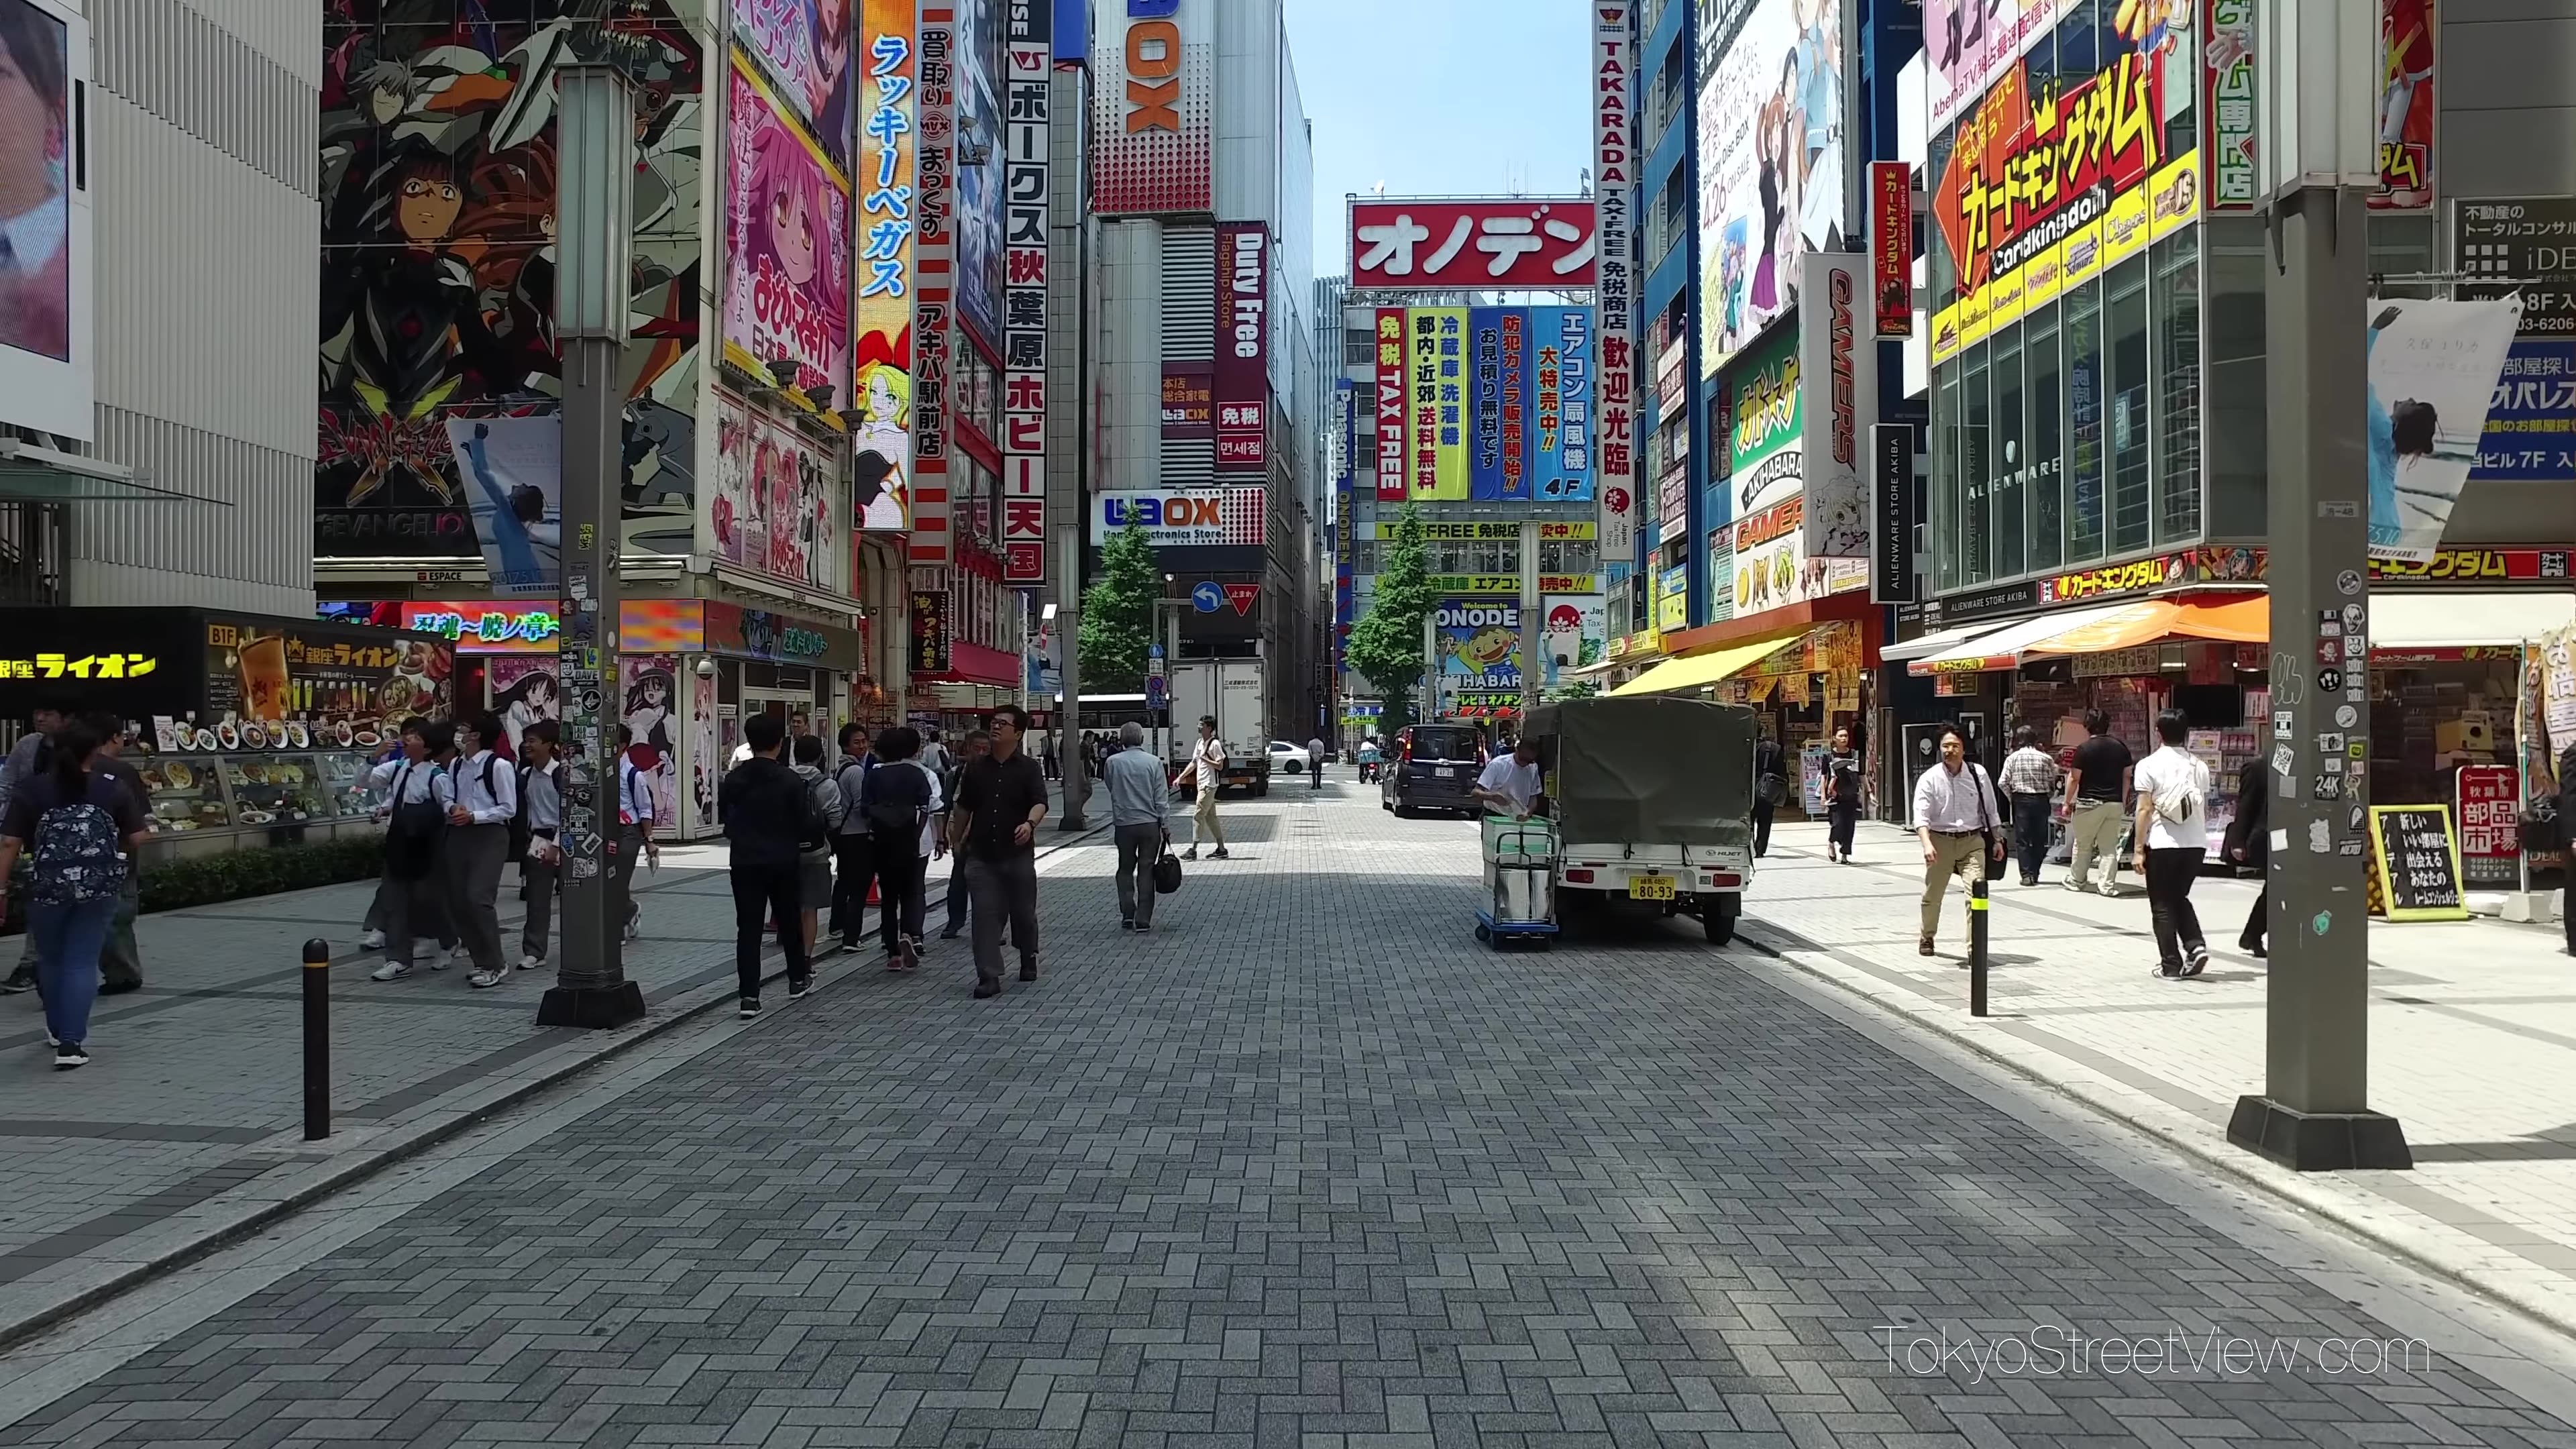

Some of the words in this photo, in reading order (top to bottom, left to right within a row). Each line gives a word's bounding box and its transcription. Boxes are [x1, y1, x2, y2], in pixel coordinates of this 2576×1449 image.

[920, 29, 951, 107] 買取り
[1599, 42, 1626, 182] TAKARADA
[860, 33, 912, 298] ラッキーベガス
[1010, 84, 1046, 242] ボークス
[1703, 161, 1722, 191] Blu-ray
[1721, 142, 1735, 171] Disc
[1735, 115, 1750, 144] BOX
[1958, 52, 2161, 288] カードキングダム
[1703, 172, 1727, 231] 4.26
[1727, 176, 1737, 195] ON
[1737, 153, 1750, 181] SALE
[1885, 180, 1899, 275] カードキングダム
[2465, 205, 2525, 220] 不動産の
[2465, 221, 2576, 237] トータルコンサル
[1356, 204, 1595, 276] オノデン
[1219, 233, 1233, 288] Flagship
[1234, 232, 1263, 293] Duty
[1219, 291, 1232, 329] Store
[1601, 262, 1628, 330] 免税商店
[2526, 292, 2555, 311] 8F
[1234, 299, 1263, 358] Free
[1379, 315, 1401, 366] 免税
[1440, 316, 1460, 378] 冷蔵庫
[916, 304, 943, 458] アキバ駅前店
[1162, 377, 1187, 389] 本店
[1829, 268, 1856, 474] GAMERS
[1162, 389, 1210, 402] 総合家電
[1379, 370, 1401, 419] TAX
[1416, 316, 1437, 491] 都内・近郊送料無料
[1479, 328, 1499, 468] お見積り無料です
[1603, 337, 1630, 477] 歓迎光臨
[1007, 250, 1045, 581] 秋葉原ホビー天国
[1221, 407, 1260, 426] 免税
[1440, 384, 1460, 446] 洗濯機
[1220, 441, 1260, 456] 면세점
[1336, 390, 1352, 480] Panasonic
[1379, 425, 1401, 490] FREE
[1890, 438, 1899, 474] AKIBA
[2519, 451, 2546, 468] 7F
[1968, 456, 2061, 501] ALIENWARE
[1890, 477, 1899, 519] STORE
[1103, 529, 1130, 539] Hom
[1193, 528, 1222, 539] Store
[1338, 490, 1350, 565] ONODEN
[1426, 524, 1474, 538] FREE
[1478, 523, 1520, 538] 免税店
[1890, 520, 1899, 590] ALIENWARE
[429, 572, 462, 581] ESPACE
[1231, 590, 1253, 598] 止まれ
[1428, 576, 1469, 591] 冷蔵庫
[2071, 559, 2163, 596] カードキングダム
[1436, 608, 1521, 627] ONODE
[1461, 602, 1497, 610] Welcome
[1499, 602, 1508, 610] to
[1950, 598, 1984, 613] ALIENWARE
[1985, 595, 2006, 607] STORE
[2007, 590, 2027, 603] AKIBA
[212, 628, 234, 645] B1F
[305, 643, 398, 667] 銀座ライオン
[2315, 775, 2340, 793] 24K
[2469, 786, 2510, 798] 秋葉原
[2399, 812, 2427, 830] 新しい
[2464, 801, 2518, 826] 部品
[2402, 832, 2449, 849] いい部屋に
[2463, 826, 2518, 852] 市場
[2406, 851, 2443, 869] 出会える
[2410, 869, 2447, 888] あなたの
[1639, 885, 1673, 898] 80-93
